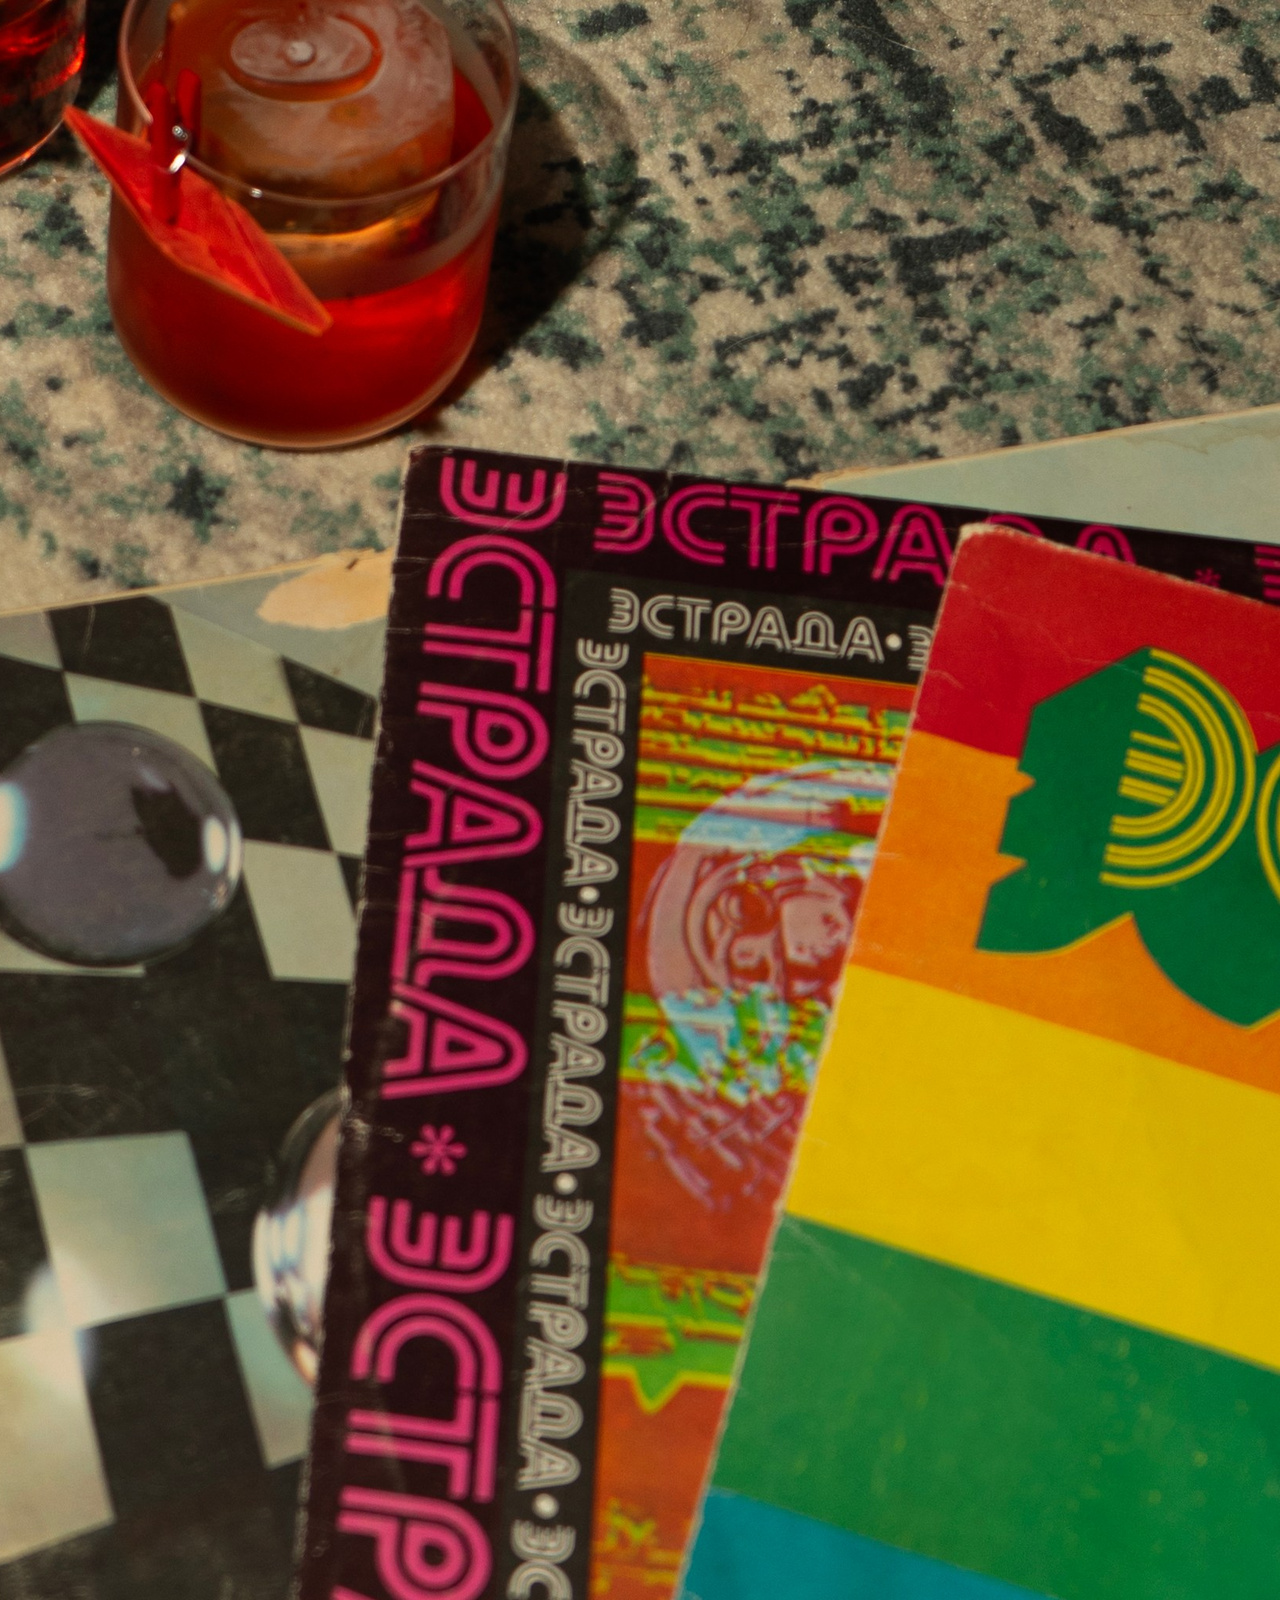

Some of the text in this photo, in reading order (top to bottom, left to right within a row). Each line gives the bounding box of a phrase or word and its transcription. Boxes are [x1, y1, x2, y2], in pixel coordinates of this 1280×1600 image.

[563, 637, 630, 888] ЭСТРАДА
[607, 587, 886, 666] ЭСТРАДА
[380, 456, 568, 1100] ЭСТРАДА
[539, 903, 614, 1173] ЭСТРАДА
[329, 1195, 515, 1600] ЭСТР
[516, 1194, 595, 1491] ЭСТРАДА
